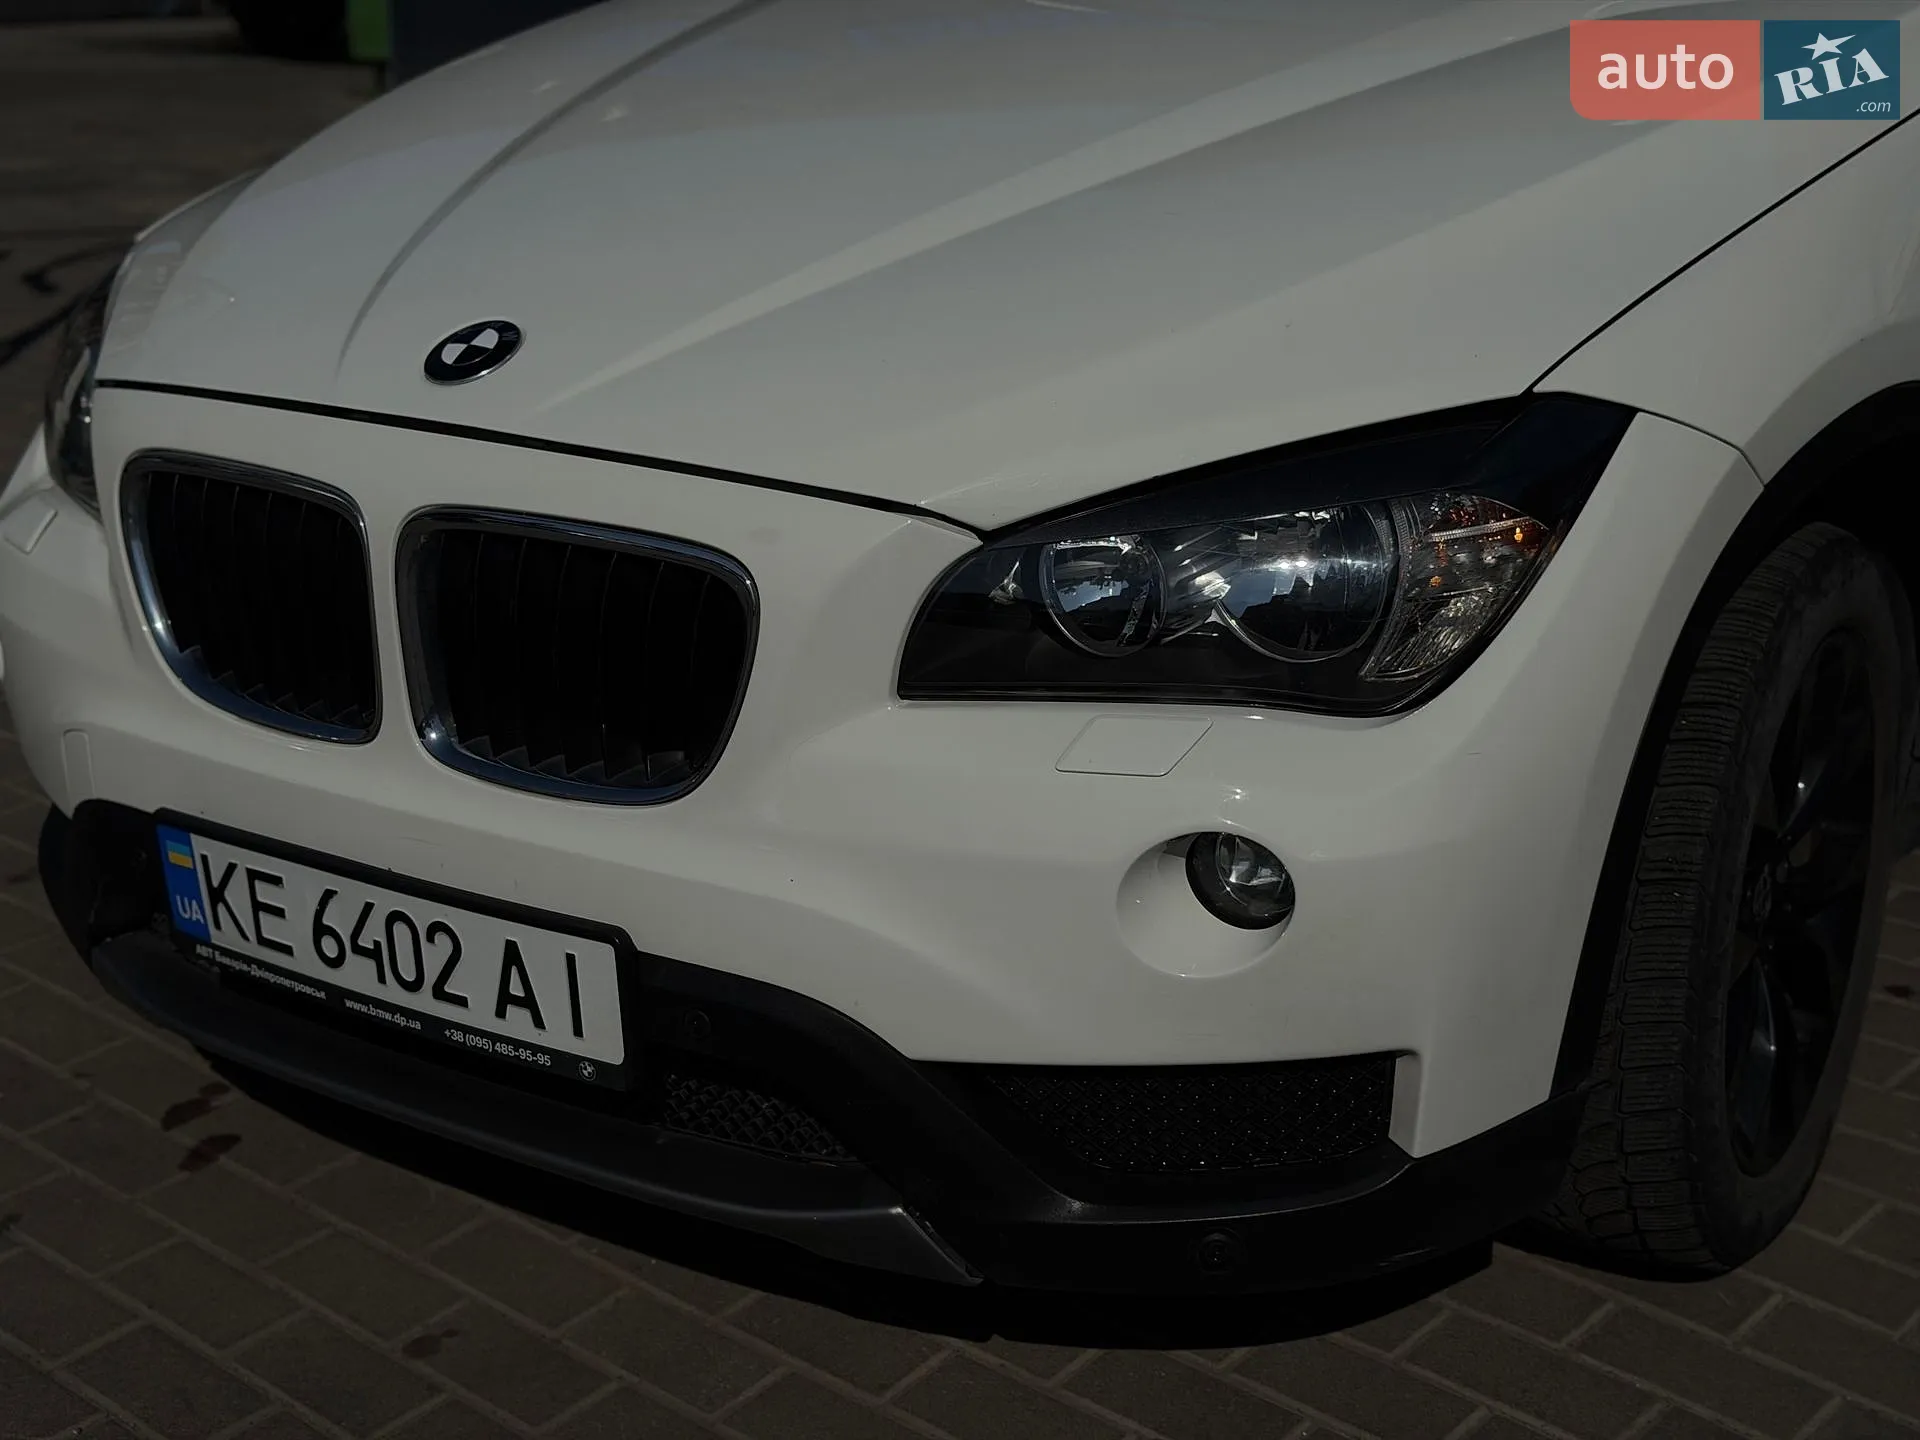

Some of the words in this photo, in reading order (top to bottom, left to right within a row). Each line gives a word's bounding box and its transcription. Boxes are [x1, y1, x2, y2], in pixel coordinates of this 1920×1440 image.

[175, 894, 205, 925] UA
[199, 852, 295, 958] KE
[312, 887, 469, 1009] 6402
[494, 938, 585, 1039] AI
[342, 997, 422, 1031] www.bmw.dp.ua
[444, 1028, 465, 1044] +38
[465, 1032, 493, 1054] (095)
[494, 1041, 552, 1067] 485-95-95
